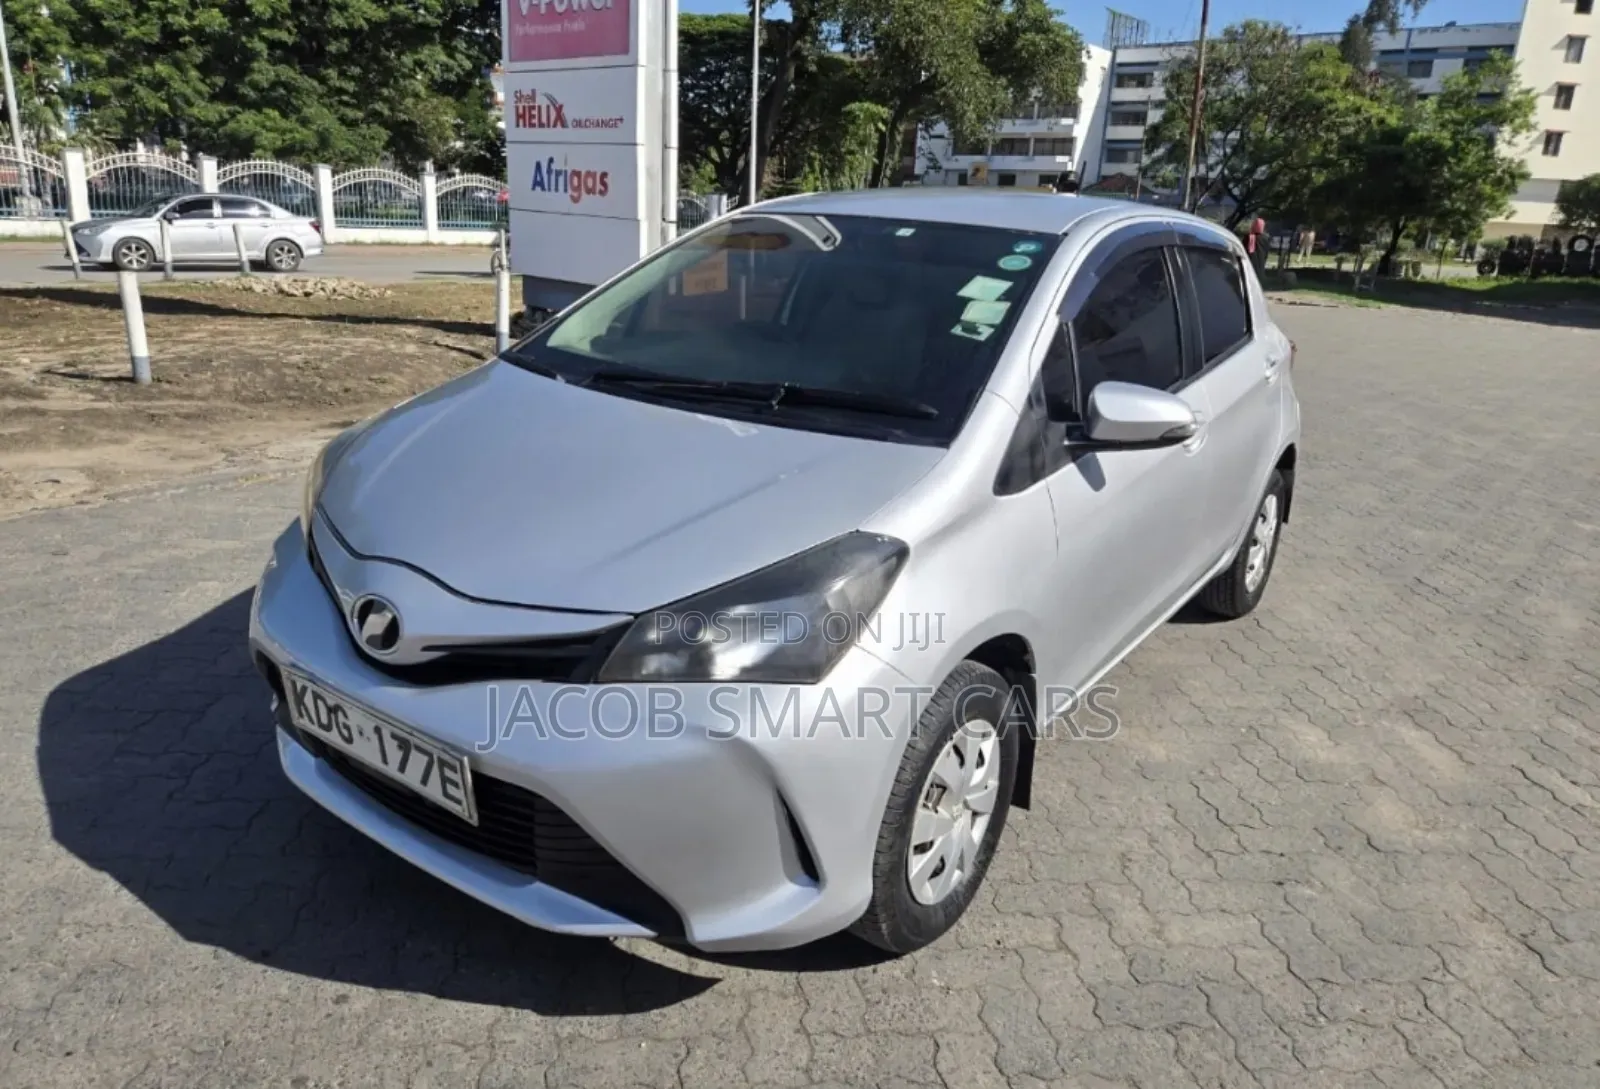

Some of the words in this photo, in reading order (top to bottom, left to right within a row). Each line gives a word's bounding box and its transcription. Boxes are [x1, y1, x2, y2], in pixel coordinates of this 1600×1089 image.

[514, 89, 536, 104] Shell
[515, 103, 569, 129] HELIX
[531, 154, 609, 204] Afrigas
[290, 679, 354, 745] KDG
[373, 725, 464, 806] 177E
